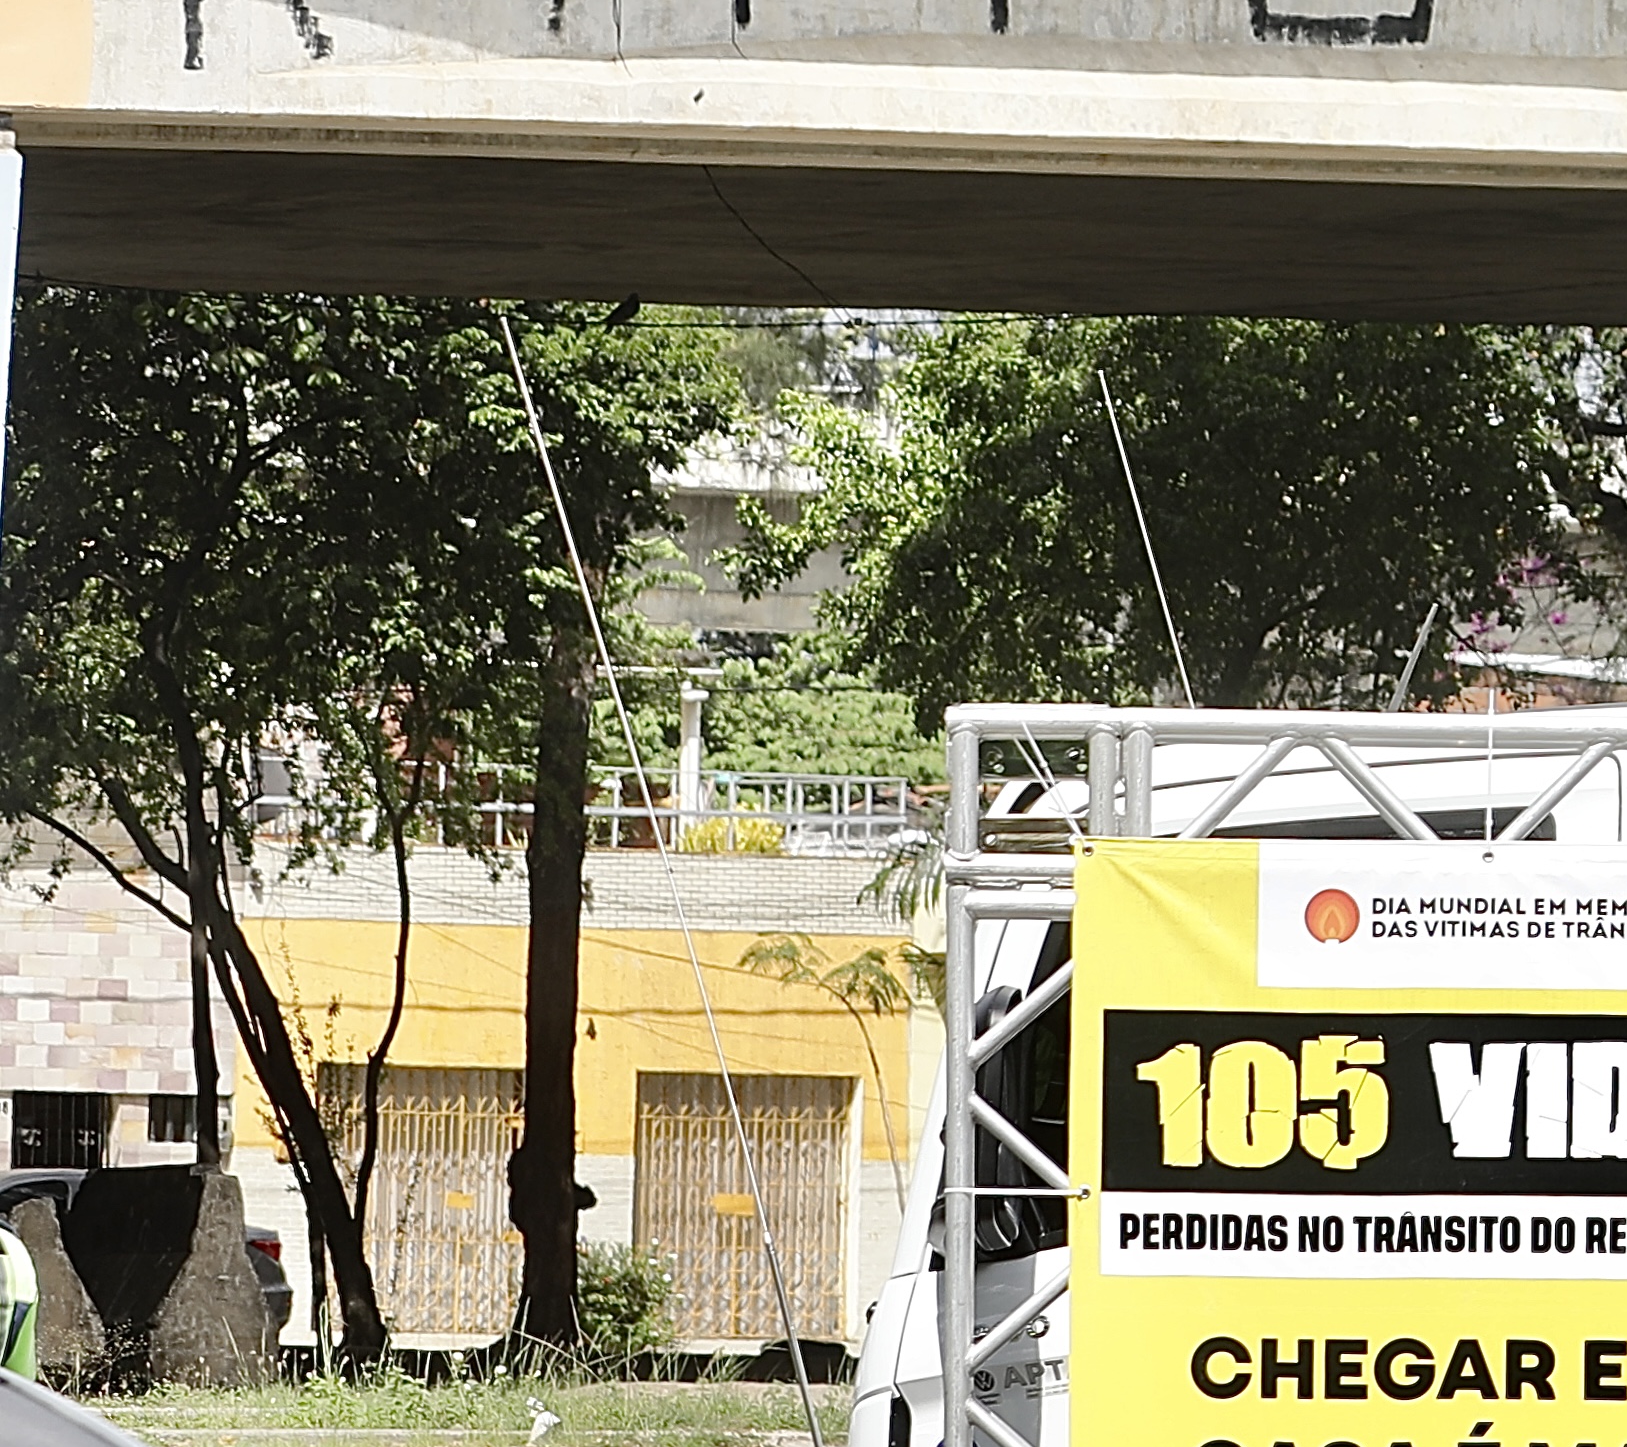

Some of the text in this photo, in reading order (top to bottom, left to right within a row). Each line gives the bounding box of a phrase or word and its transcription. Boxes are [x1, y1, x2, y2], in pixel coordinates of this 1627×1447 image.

[1372, 897, 1411, 915] DIA
[1419, 897, 1526, 916] MUNDIAL
[1534, 898, 1567, 916] EM
[1372, 920, 1418, 938] DAS
[1527, 921, 1555, 939] DE
[1136, 1033, 1390, 1171] 105
[1119, 1212, 1289, 1252] PERDIDAS
[1298, 1214, 1345, 1253] NO
[1352, 1210, 1521, 1254] TRÂNSITO
[1530, 1215, 1576, 1254] DO
[1004, 1358, 1070, 1390] APT
[1190, 1335, 1560, 1402] CHEGAR
